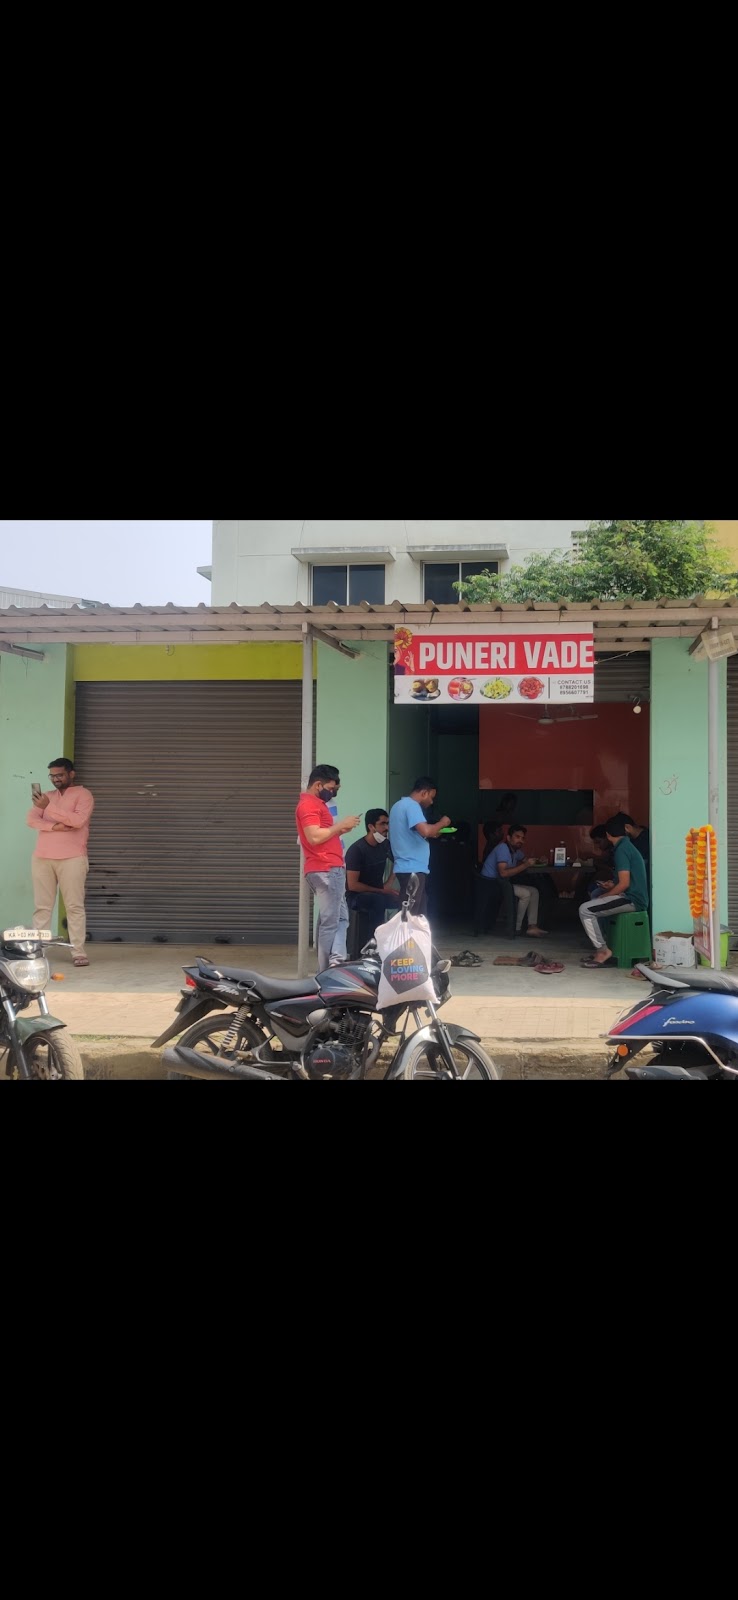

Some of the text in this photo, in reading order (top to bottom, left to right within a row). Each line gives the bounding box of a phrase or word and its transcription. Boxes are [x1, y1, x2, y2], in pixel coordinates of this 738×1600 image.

[419, 640, 594, 670] PUNERI VADE
[390, 958, 414, 967] KEEP
[390, 964, 424, 974] LOVING
[390, 973, 419, 982] MORE
